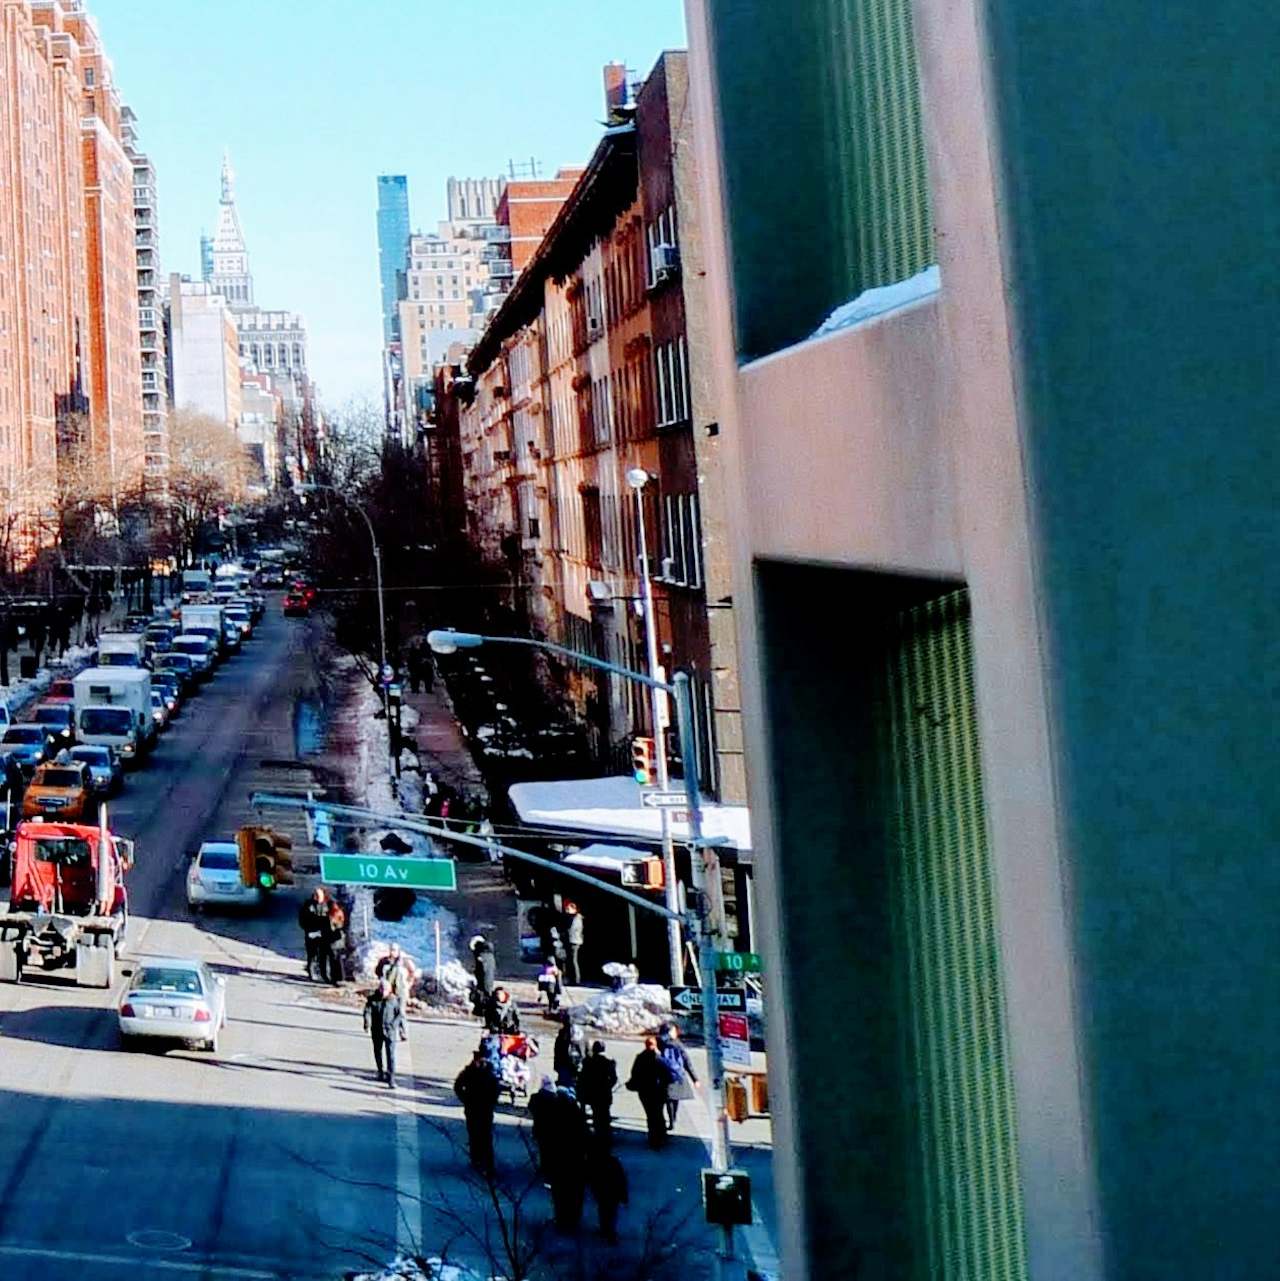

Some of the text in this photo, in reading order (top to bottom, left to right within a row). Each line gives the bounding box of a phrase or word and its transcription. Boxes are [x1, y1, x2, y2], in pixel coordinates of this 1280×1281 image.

[358, 863, 409, 881] 10 Av
[726, 955, 743, 970] 10
